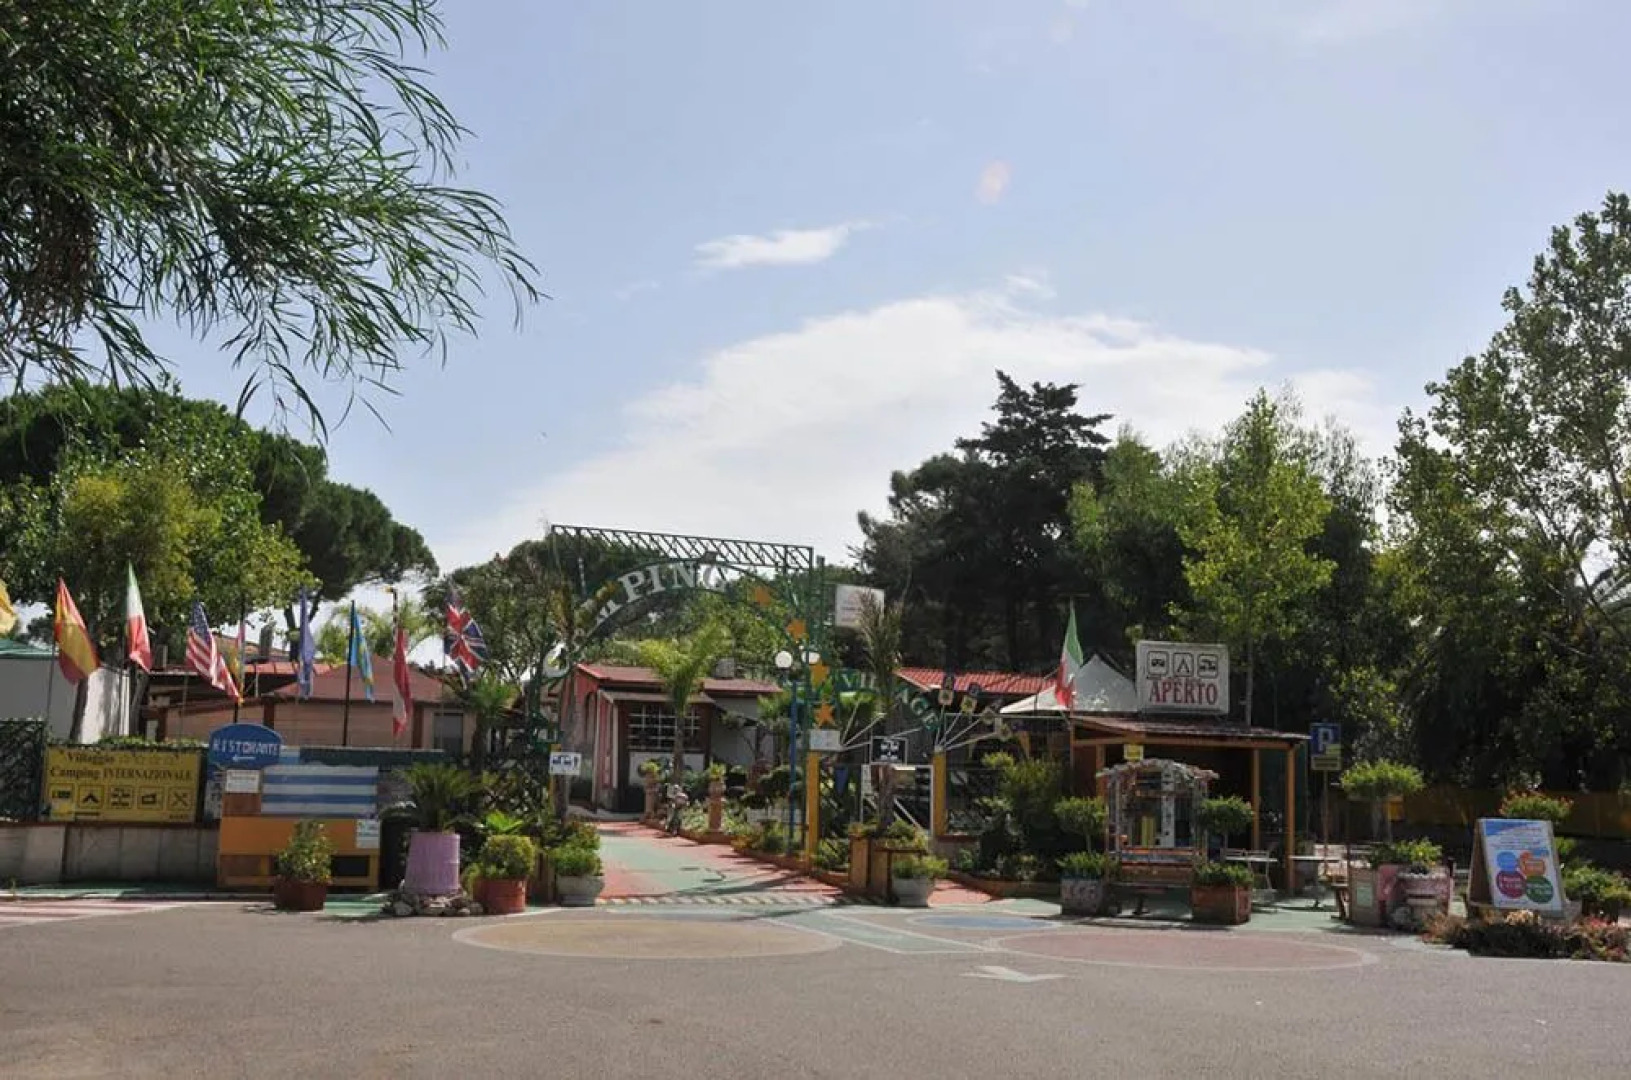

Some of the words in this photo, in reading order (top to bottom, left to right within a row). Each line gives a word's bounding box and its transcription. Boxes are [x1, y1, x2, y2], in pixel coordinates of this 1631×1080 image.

[543, 560, 727, 679] CMPING
[841, 671, 939, 731] VILAGE
[1148, 680, 1218, 705] APERTO
[1318, 728, 1334, 751] P
[50, 766, 100, 781] Camping
[103, 768, 192, 780] INTERNAZIONALE
